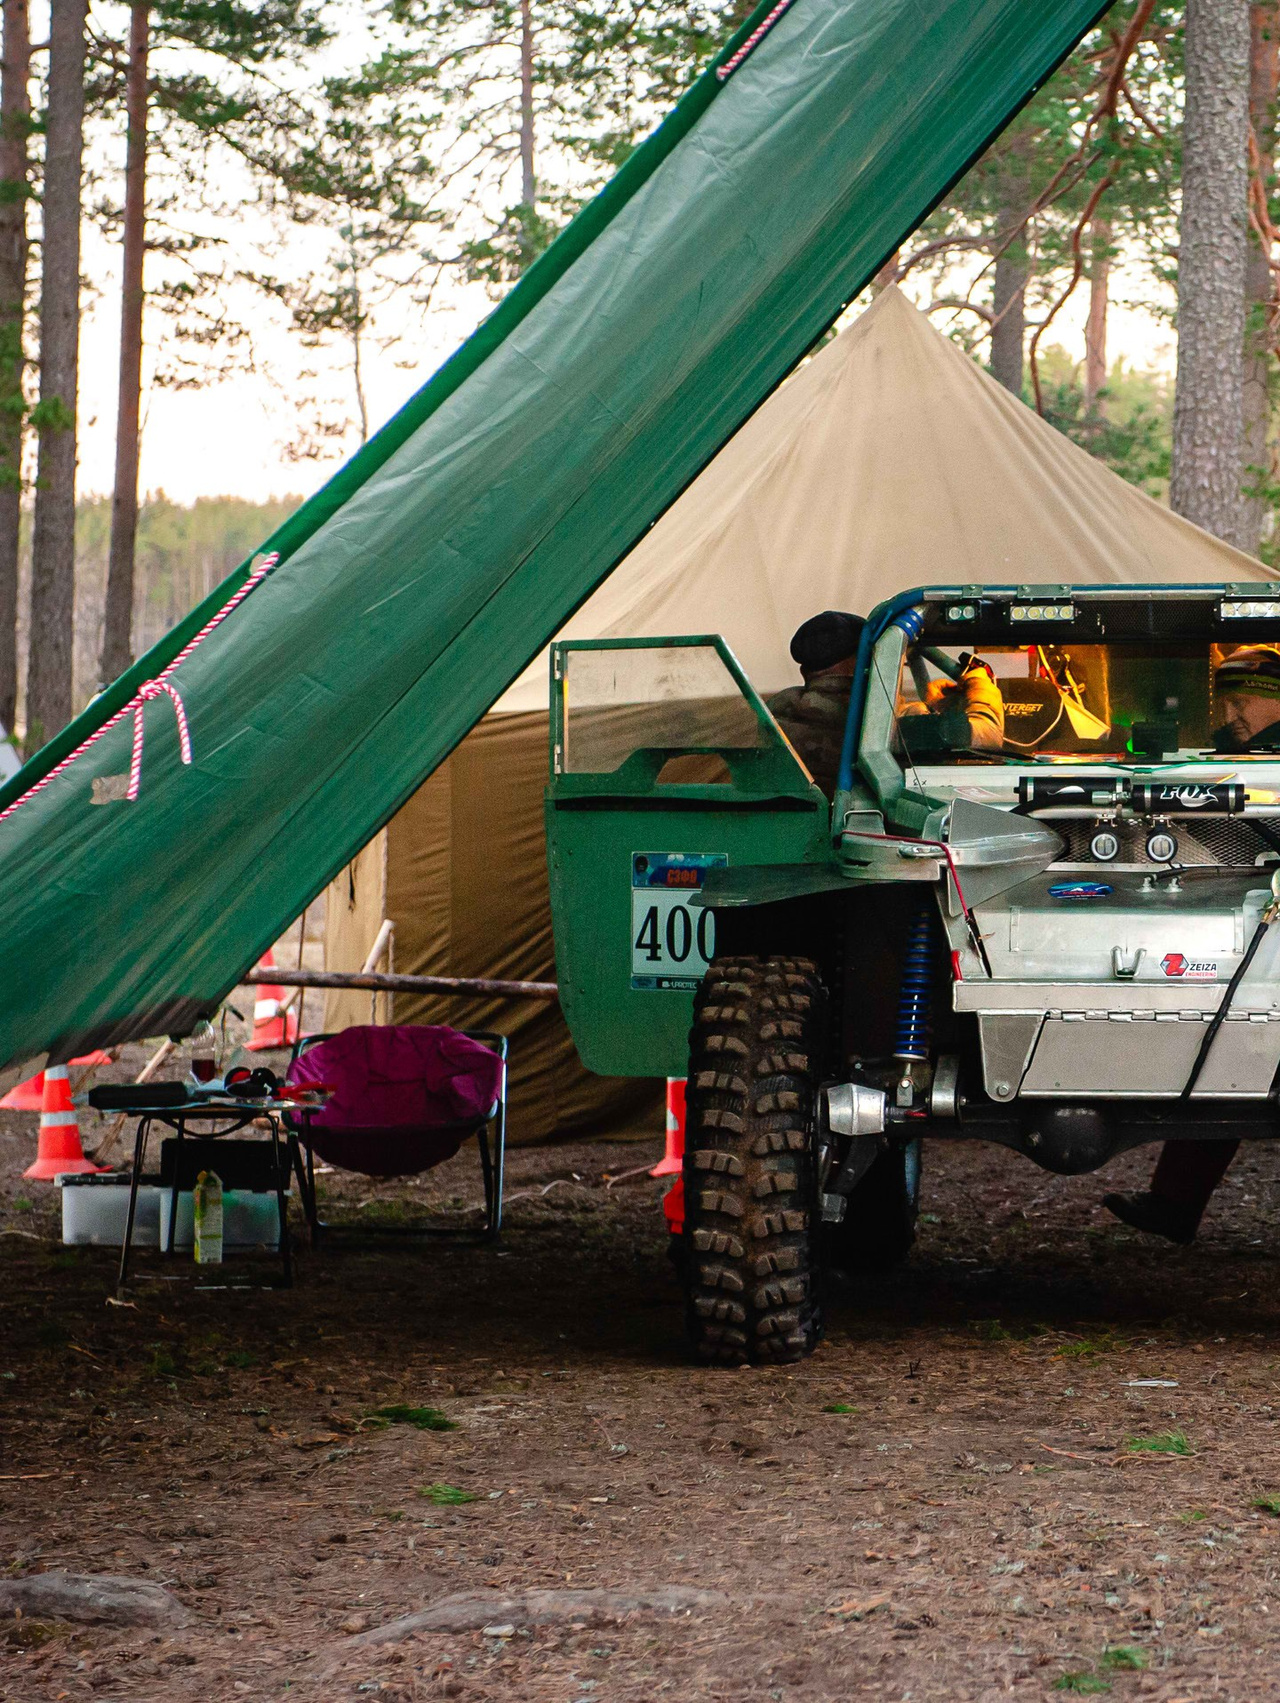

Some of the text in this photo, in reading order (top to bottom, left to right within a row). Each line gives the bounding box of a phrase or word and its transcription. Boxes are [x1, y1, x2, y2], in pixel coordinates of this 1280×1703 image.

[1160, 784, 1218, 804] FOX
[635, 904, 717, 964] 400
[1189, 963, 1217, 971] ZEIZA
